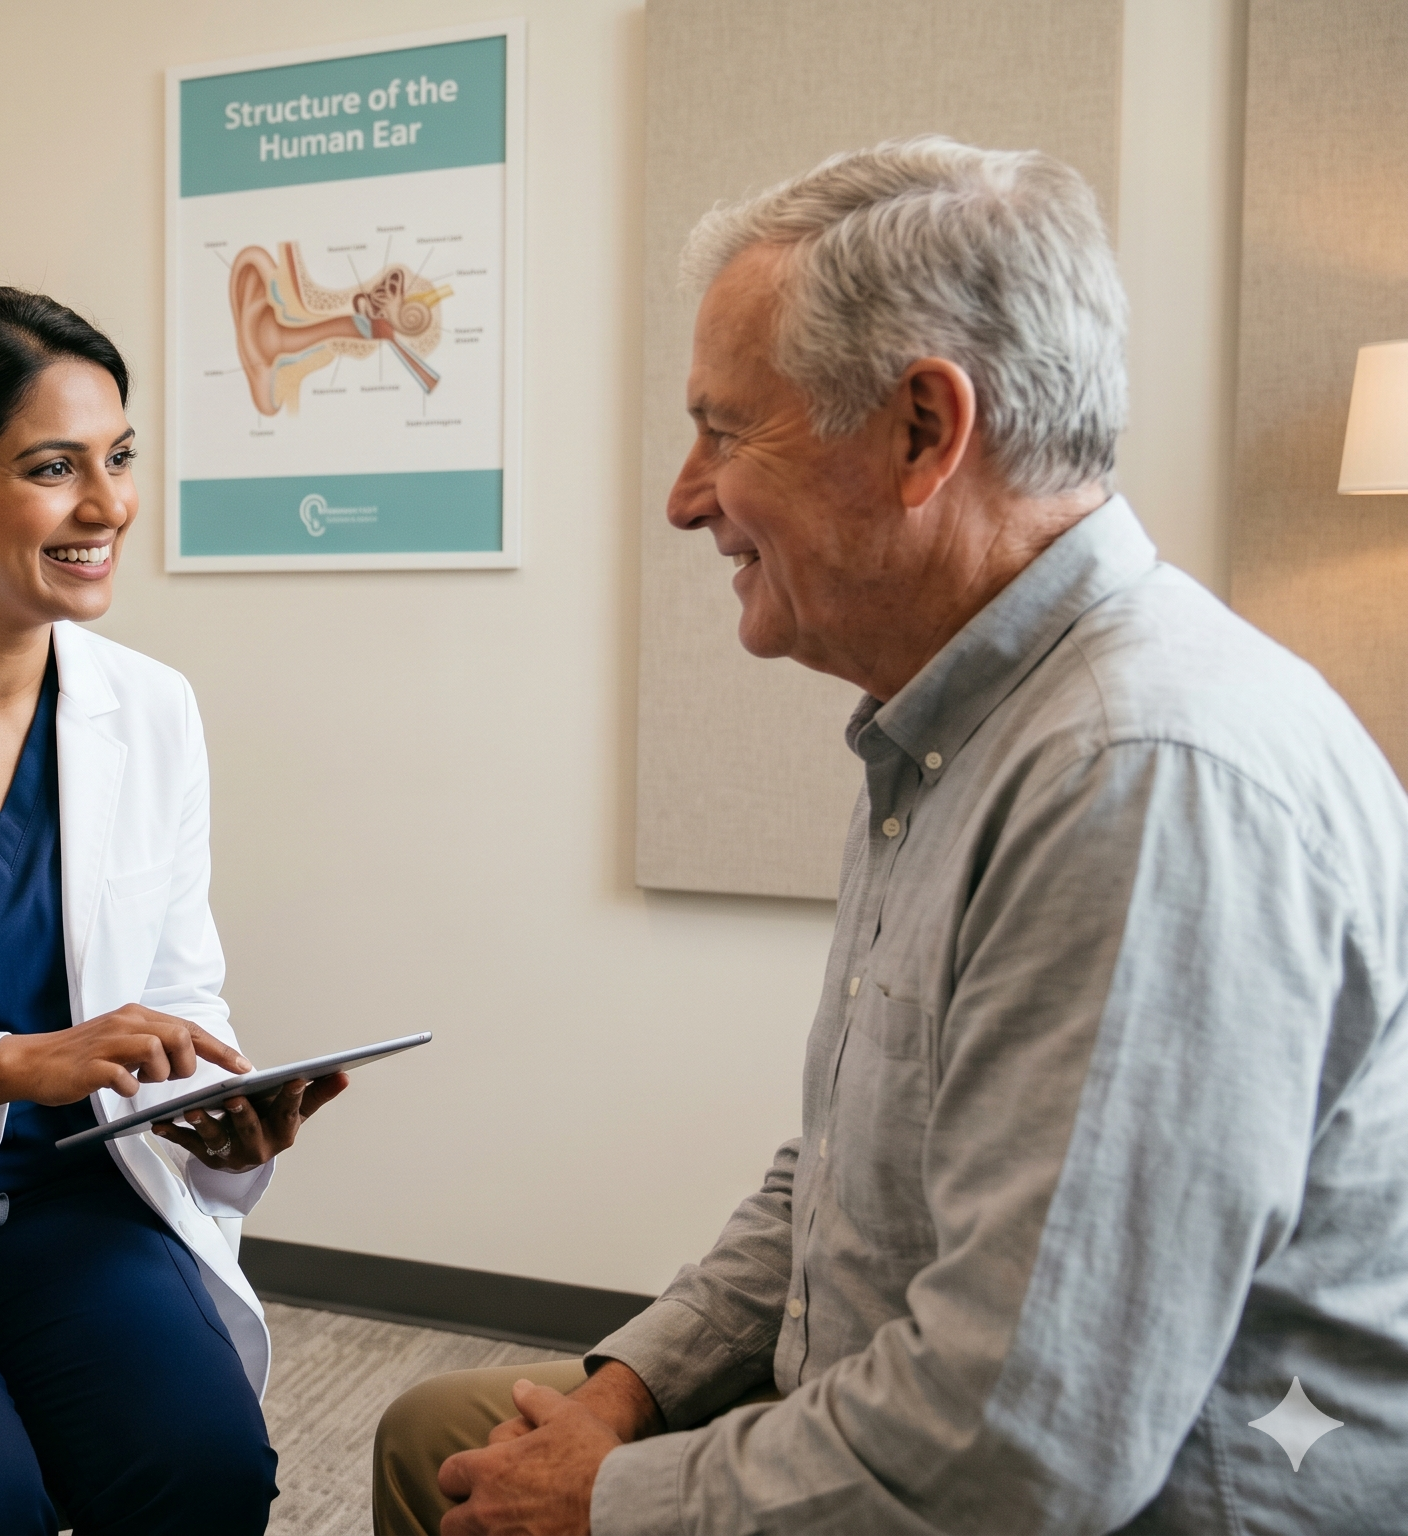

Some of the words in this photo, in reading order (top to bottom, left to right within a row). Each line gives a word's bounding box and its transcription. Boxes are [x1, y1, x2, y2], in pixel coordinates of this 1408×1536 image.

[225, 92, 361, 130] Structure
[368, 78, 401, 111] of
[406, 75, 459, 107] the
[259, 129, 364, 162] Human
[373, 120, 423, 149] Ear
